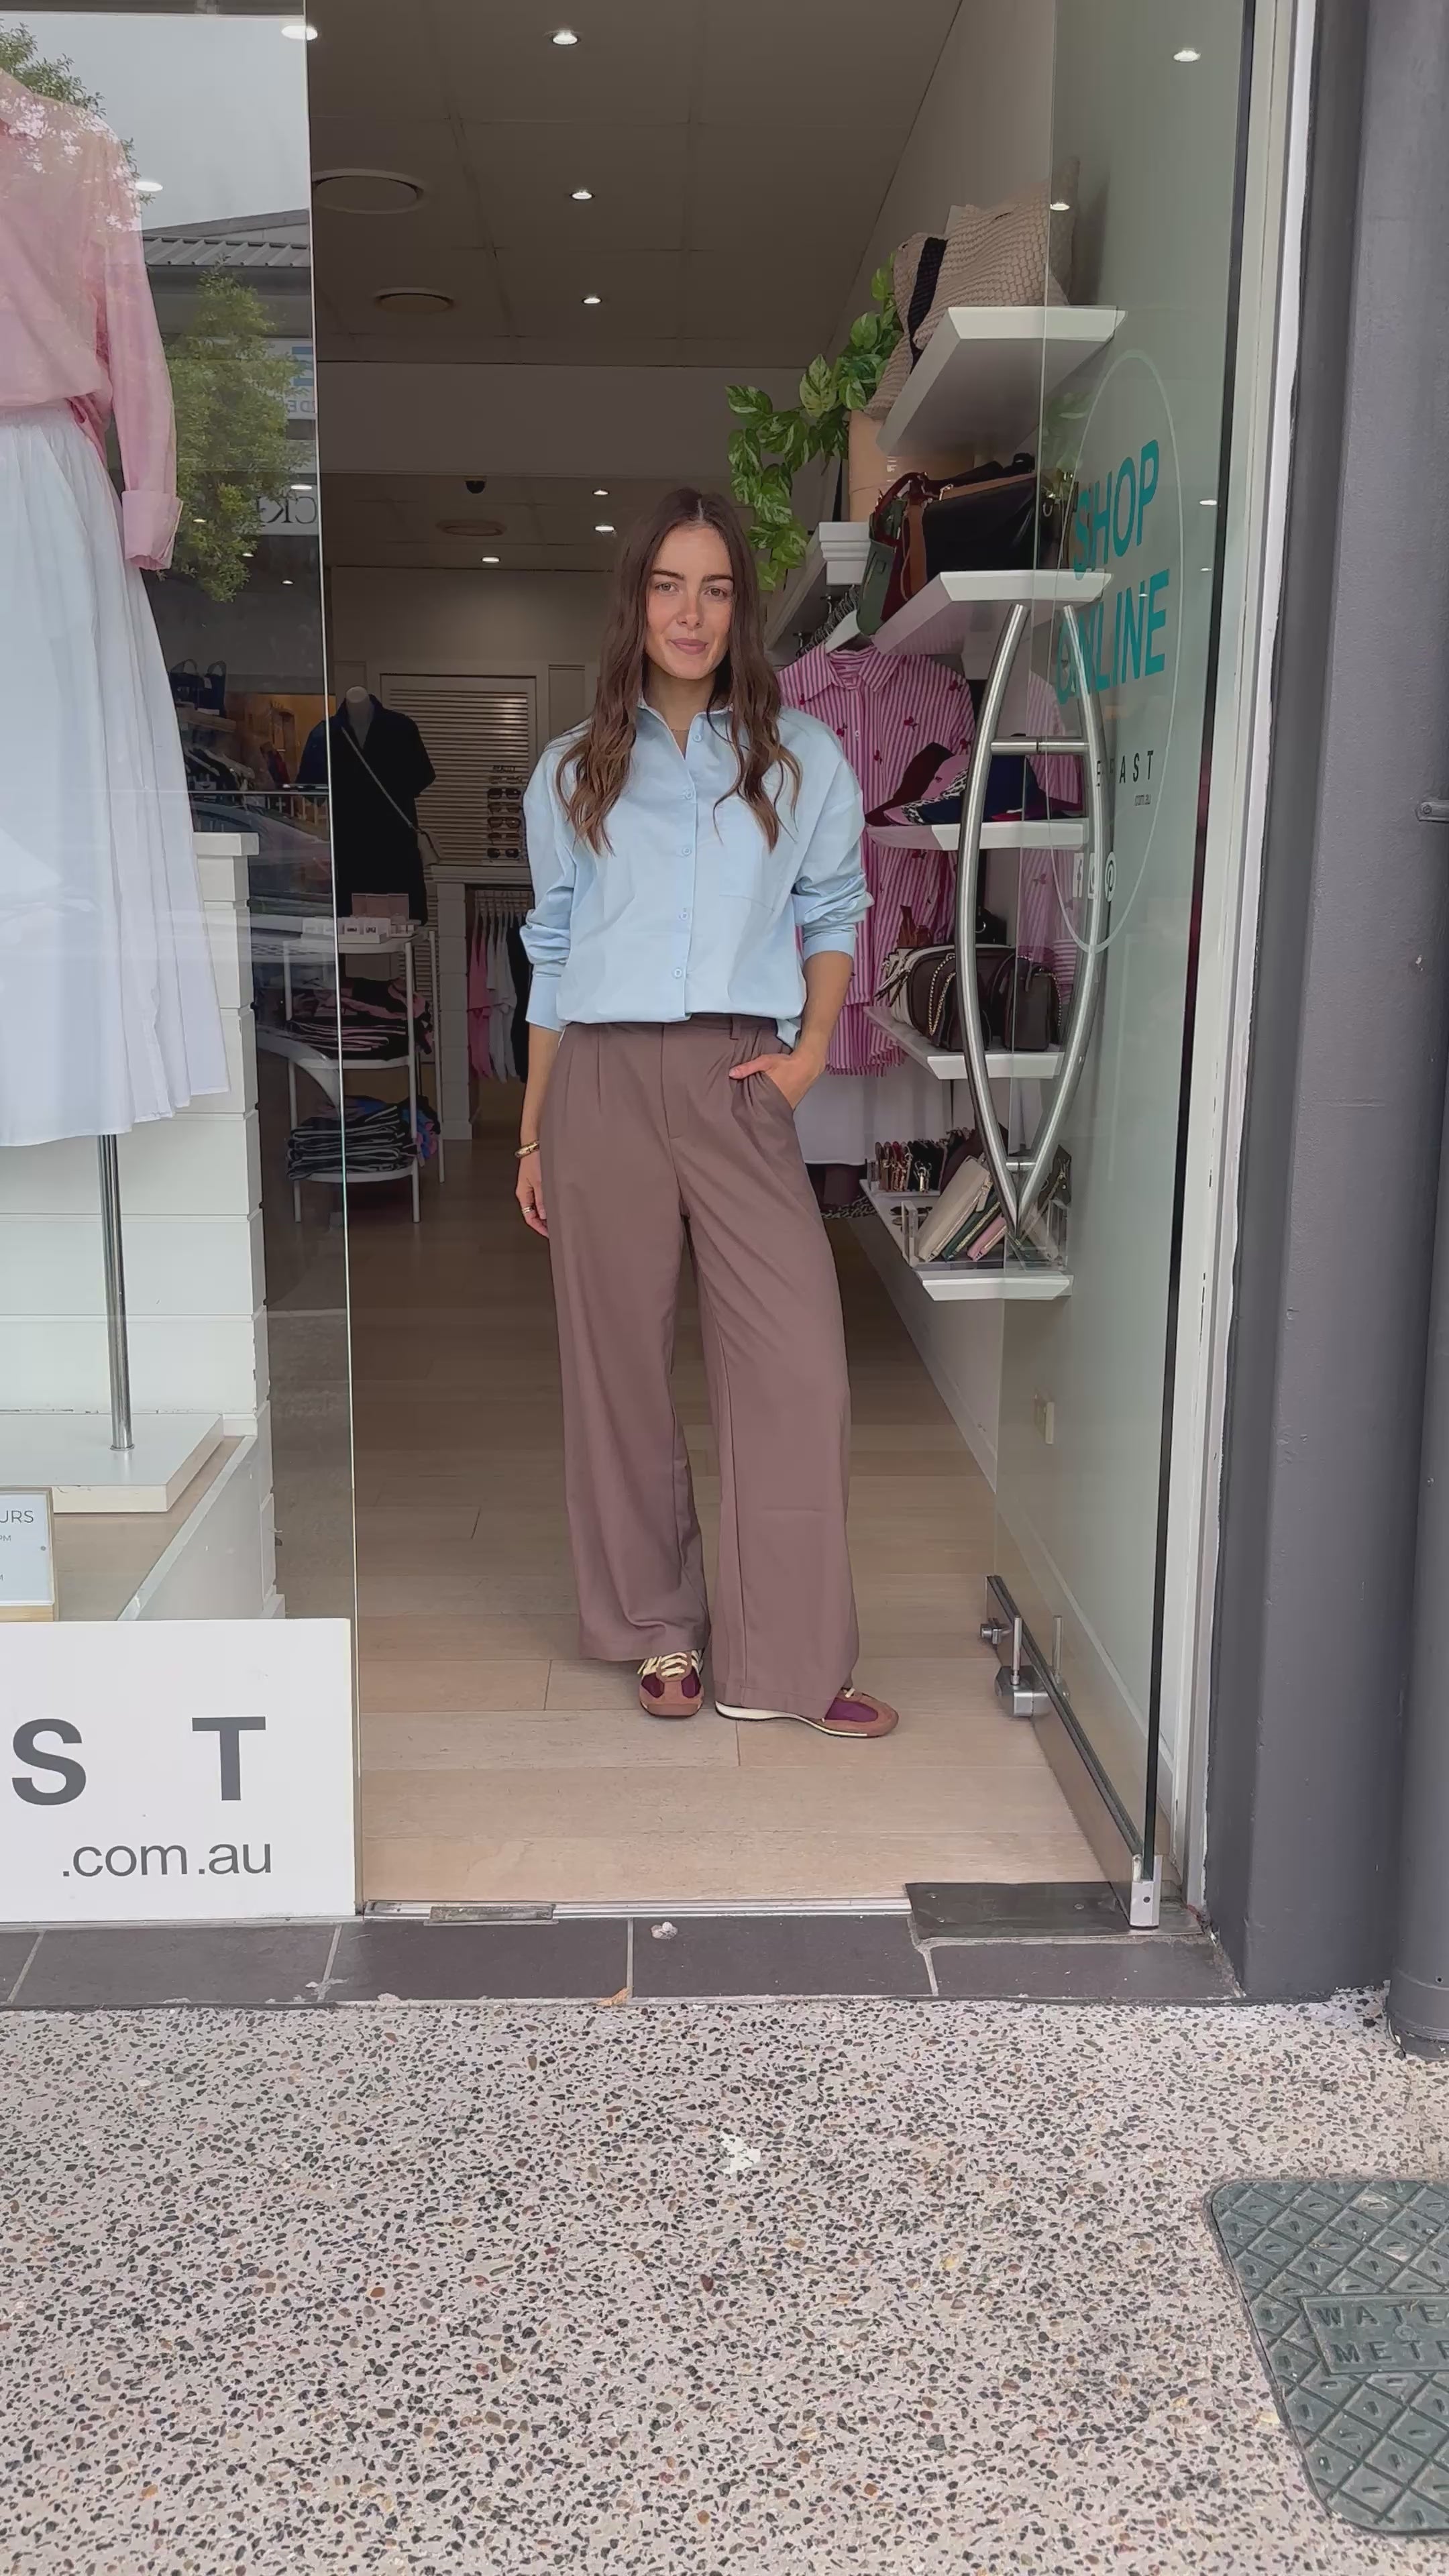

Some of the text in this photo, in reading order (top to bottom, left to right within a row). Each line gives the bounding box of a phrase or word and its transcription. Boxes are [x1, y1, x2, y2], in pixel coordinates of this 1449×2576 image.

[1074, 439, 1159, 581] SHOP
[1055, 568, 1169, 706] ONLINE
[62, 1843, 272, 1877] .com.au
